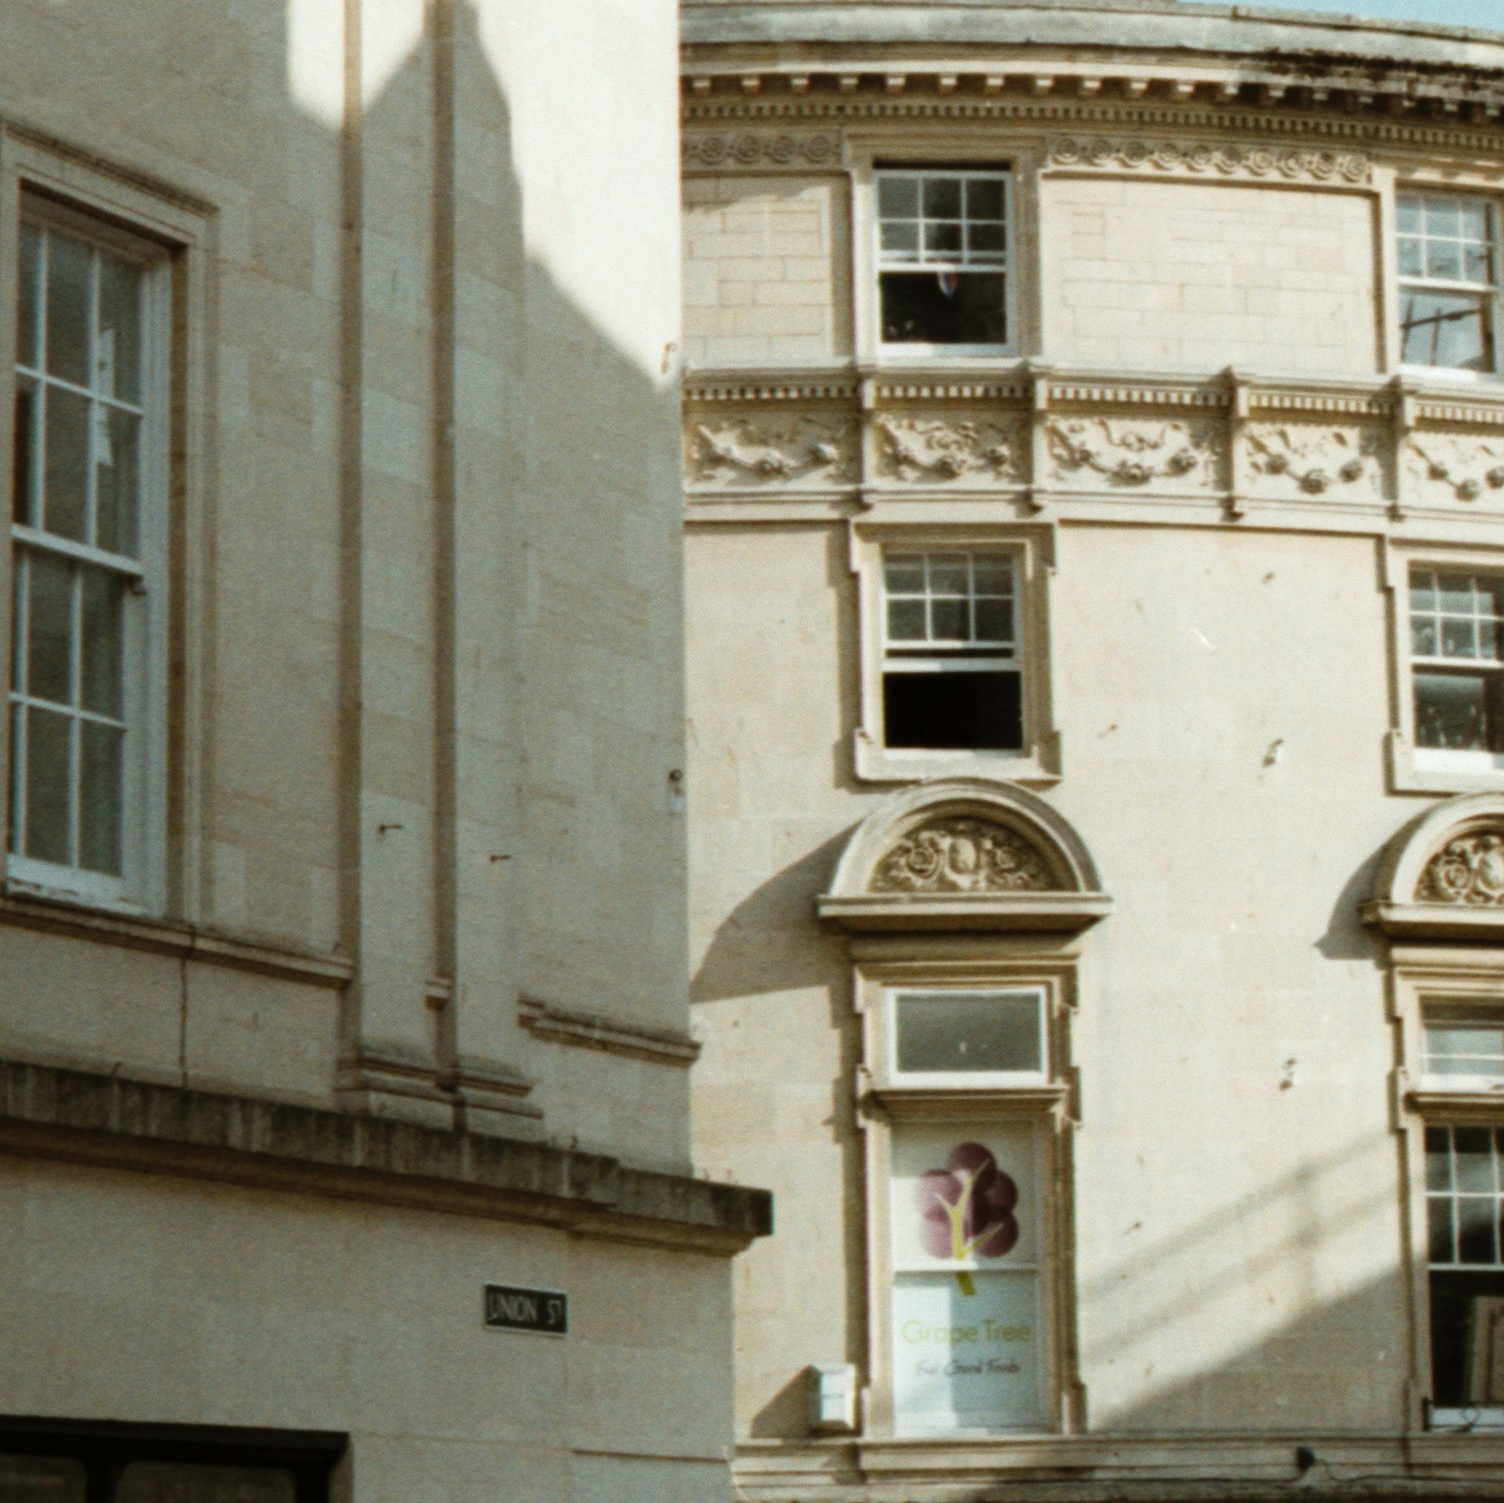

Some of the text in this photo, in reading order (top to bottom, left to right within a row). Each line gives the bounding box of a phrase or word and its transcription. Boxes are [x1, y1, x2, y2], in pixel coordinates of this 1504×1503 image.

[487, 1292, 538, 1322] UNION
[901, 1318, 1031, 1347] Grape Tree
